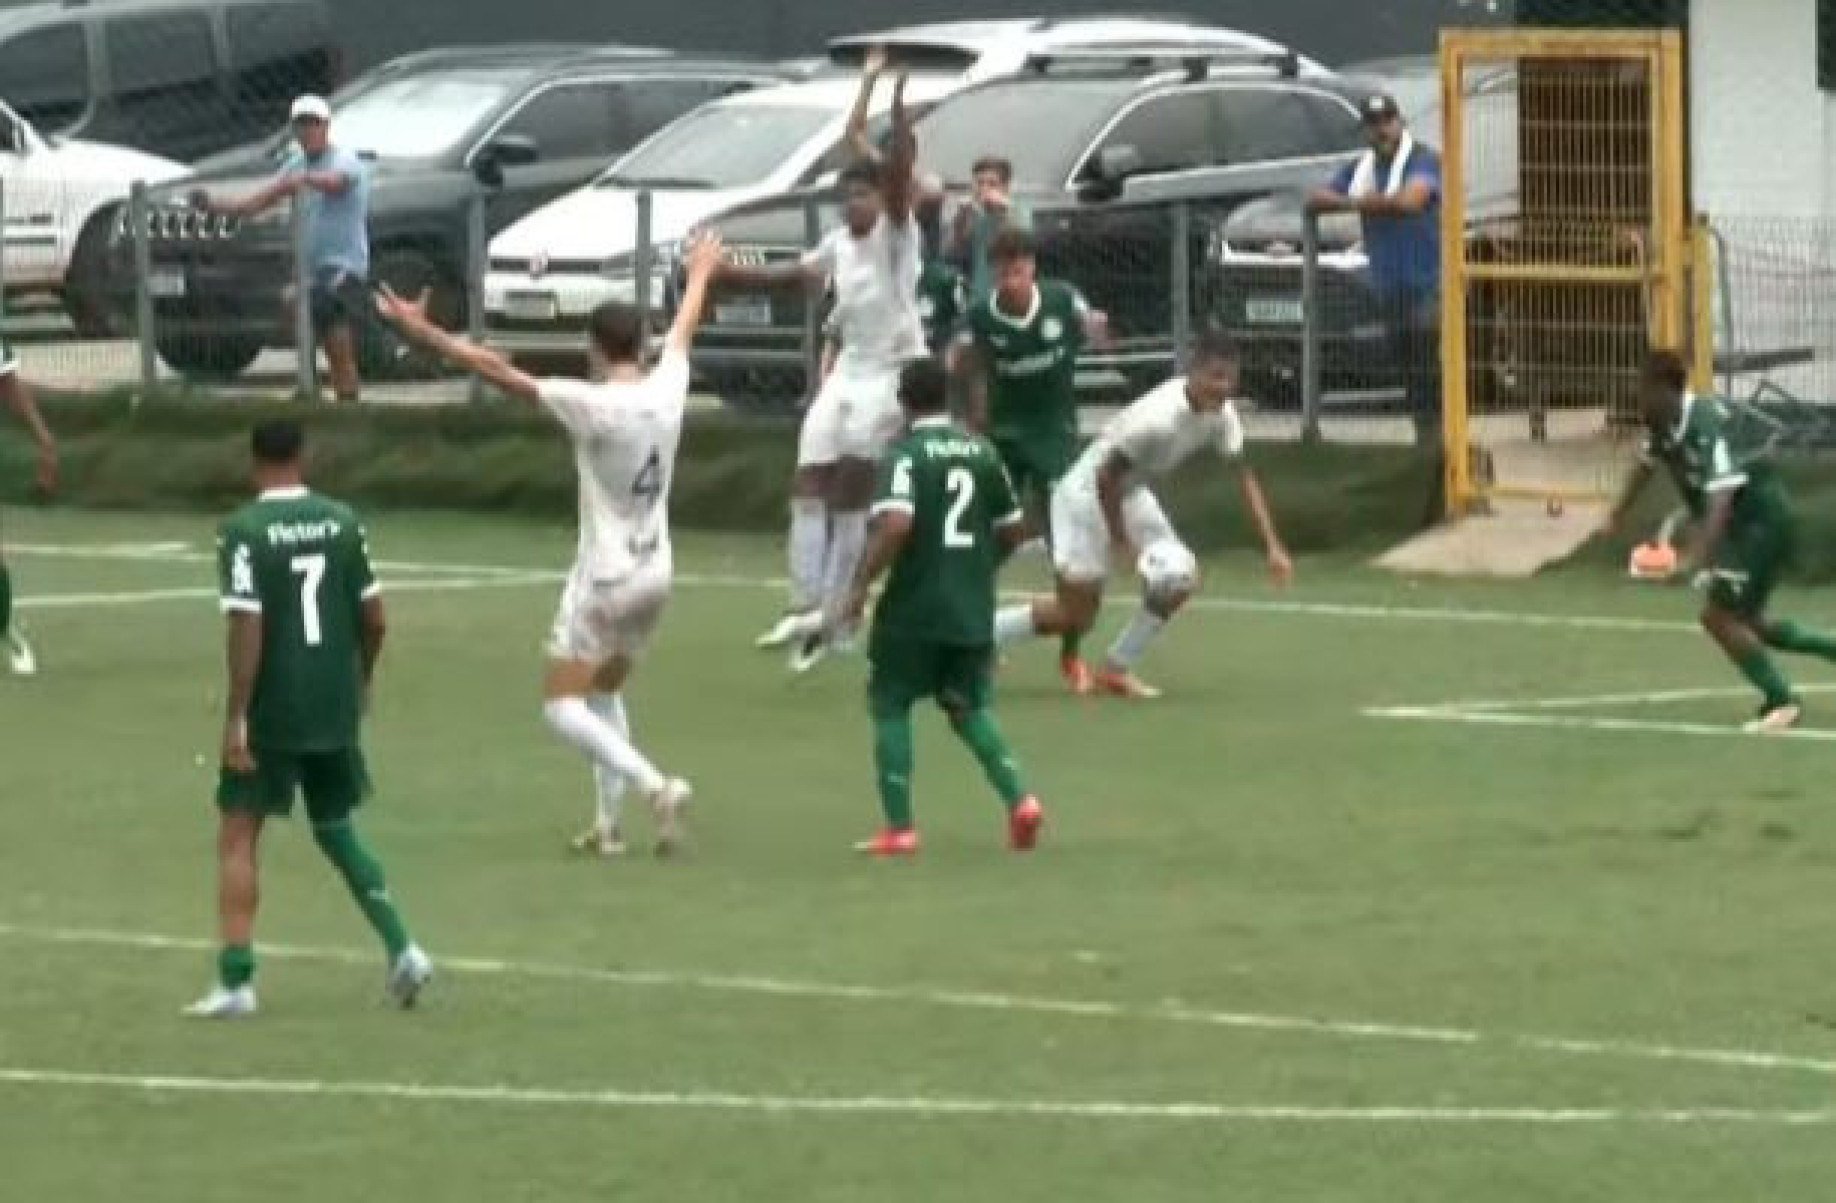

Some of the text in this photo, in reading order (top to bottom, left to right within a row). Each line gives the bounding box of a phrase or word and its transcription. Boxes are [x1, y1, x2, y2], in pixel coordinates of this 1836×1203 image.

[631, 445, 659, 512] 4
[944, 467, 975, 548] 2
[291, 554, 326, 646] 7
